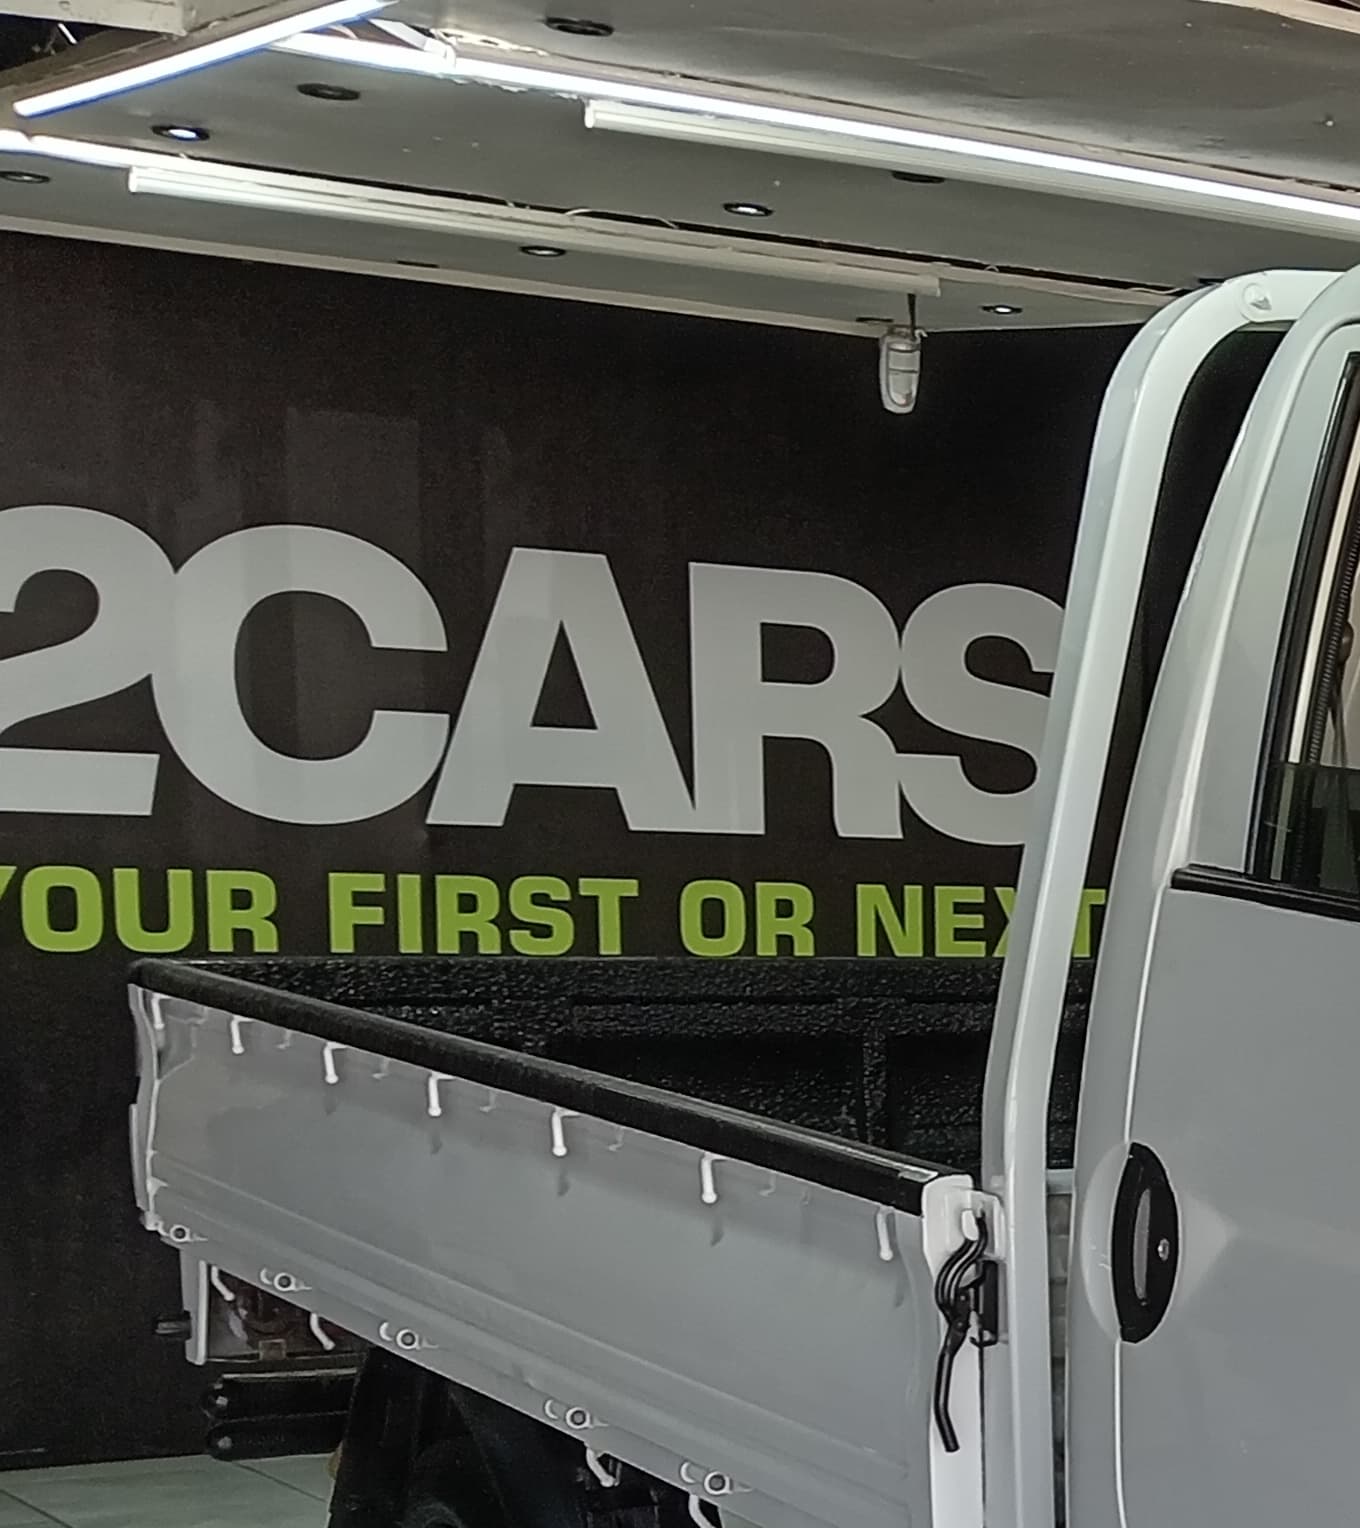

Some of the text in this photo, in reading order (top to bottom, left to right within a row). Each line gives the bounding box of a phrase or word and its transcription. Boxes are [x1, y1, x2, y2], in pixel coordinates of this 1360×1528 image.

[0, 865, 279, 954] OUR
[328, 871, 638, 957] FIRST
[679, 879, 814, 957] OR
